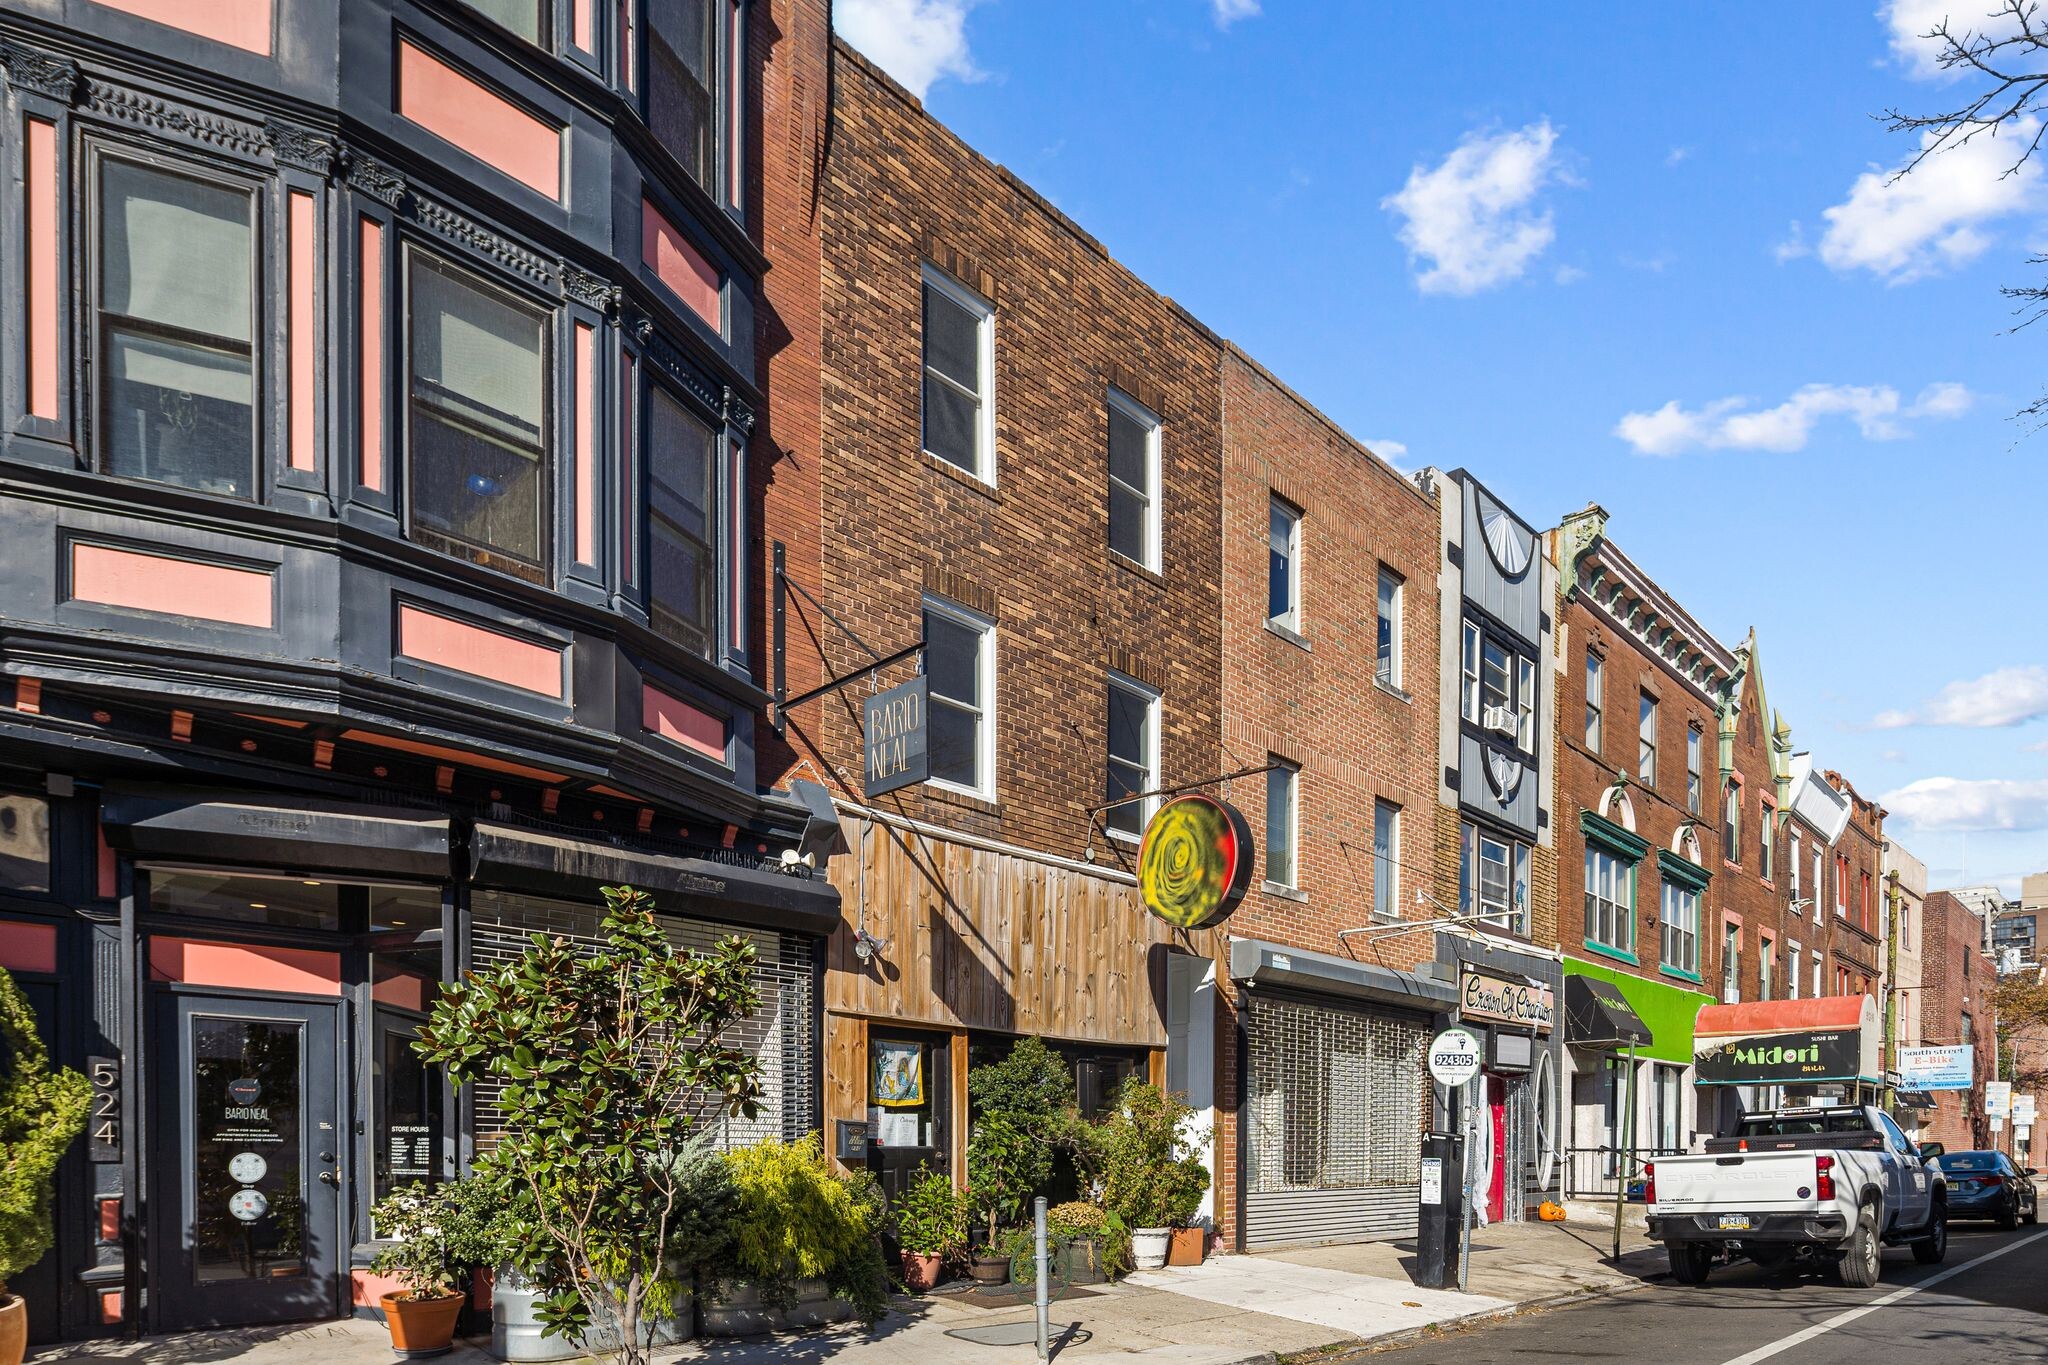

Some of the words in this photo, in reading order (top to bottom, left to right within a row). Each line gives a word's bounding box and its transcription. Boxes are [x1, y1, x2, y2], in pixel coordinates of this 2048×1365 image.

[871, 693, 919, 744] BARIO
[872, 735, 911, 781] NEAL
[1501, 986, 1515, 1020] Of
[1436, 1055, 1472, 1066] 924305
[1733, 1044, 1819, 1066] Midori
[1914, 1055, 1954, 1065] E-Bike
[94, 1063, 116, 1145] 524
[225, 1107, 250, 1120] BARIO
[250, 1107, 270, 1121] NEAL
[391, 1125, 410, 1133] STORE
[1664, 1170, 1805, 1184] CHEVROLET
